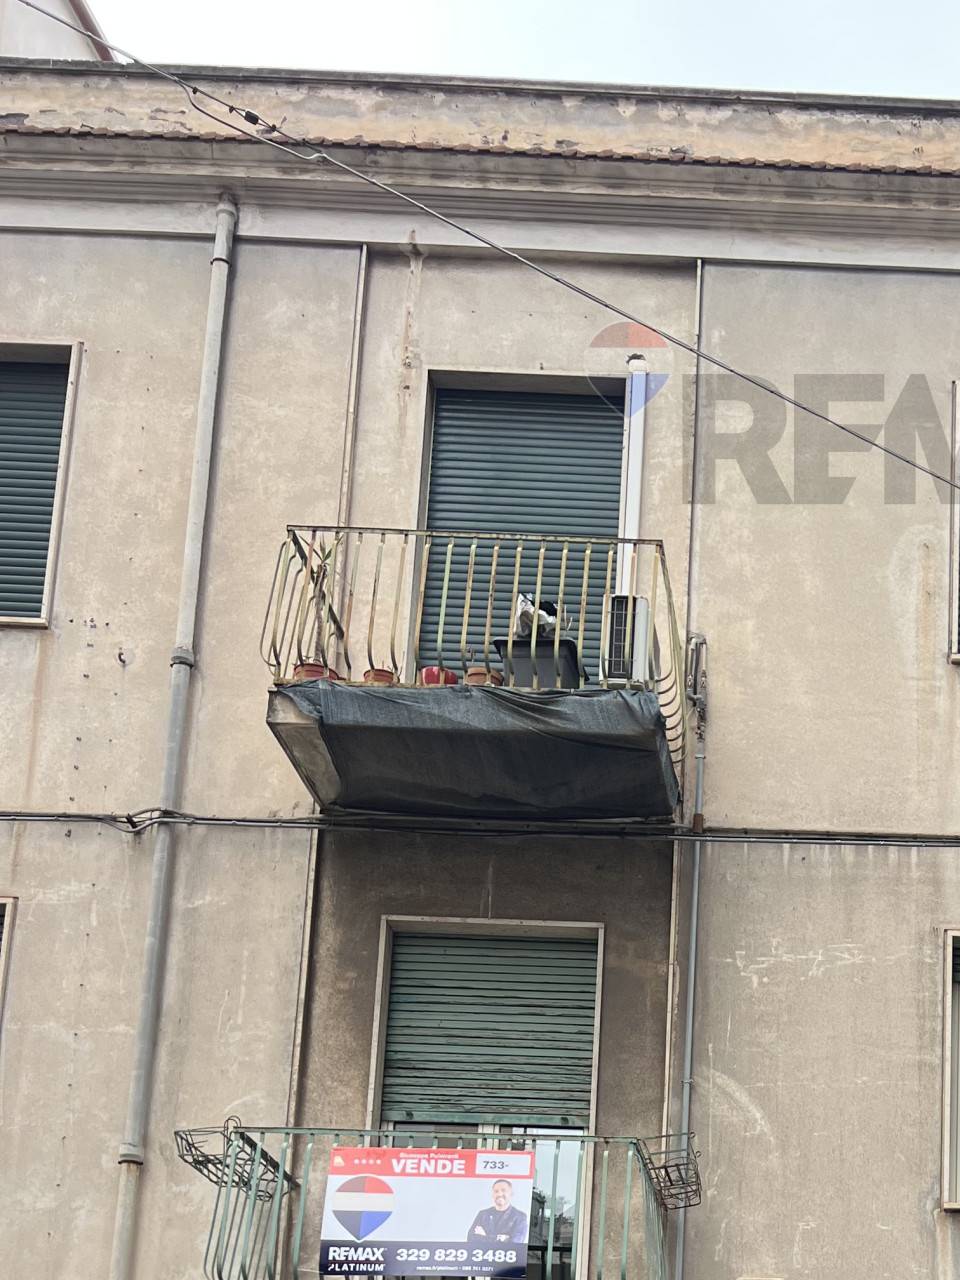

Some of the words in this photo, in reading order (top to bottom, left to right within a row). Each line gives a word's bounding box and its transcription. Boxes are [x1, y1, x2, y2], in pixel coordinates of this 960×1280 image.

[392, 1158, 466, 1174] VENDE
[396, 1248, 431, 1261] 329
[434, 1248, 468, 1261] 829
[471, 1249, 517, 1263] 3488
[327, 1263, 386, 1272] PLATINUM
